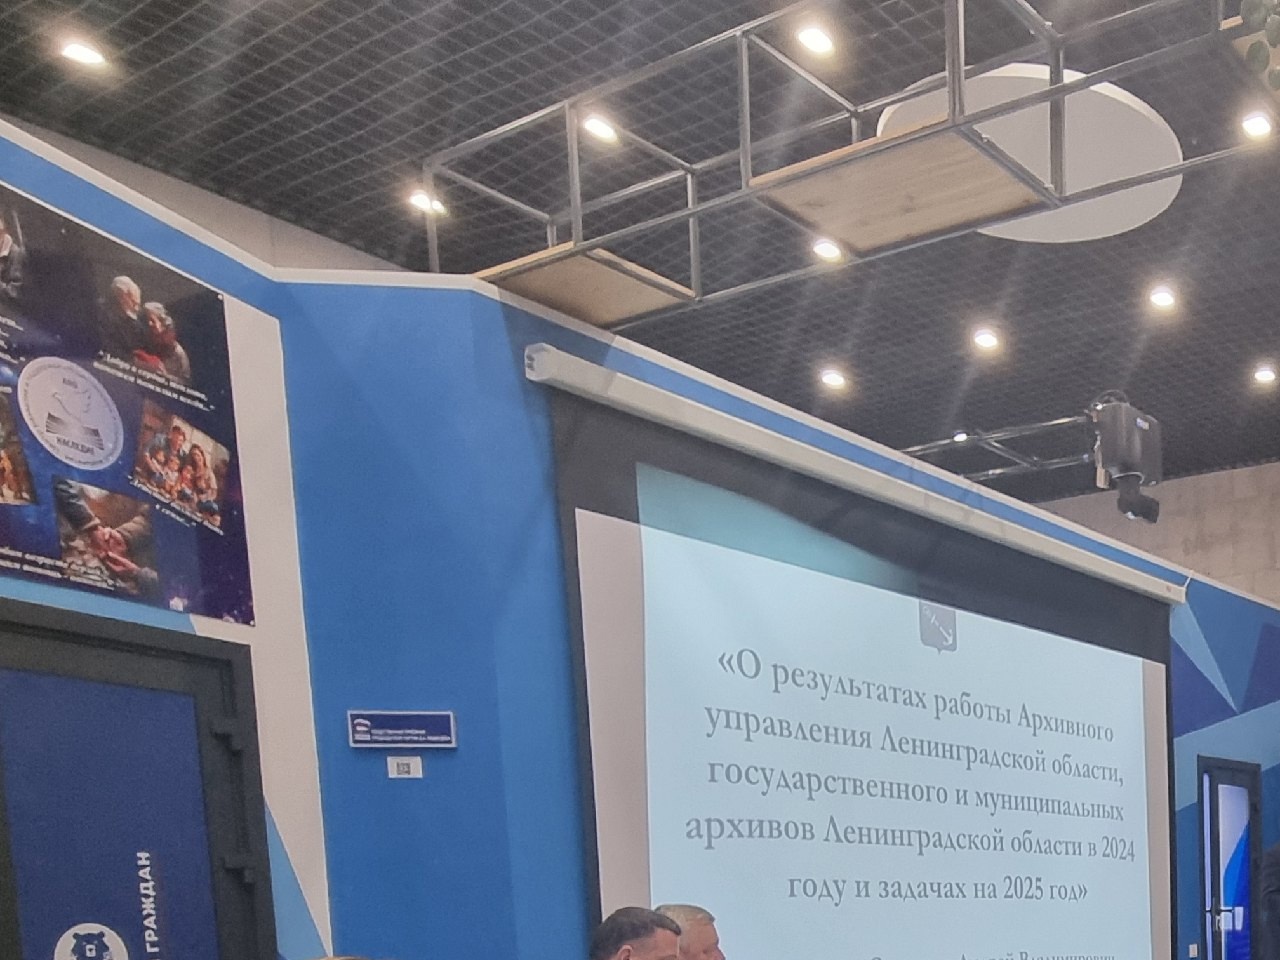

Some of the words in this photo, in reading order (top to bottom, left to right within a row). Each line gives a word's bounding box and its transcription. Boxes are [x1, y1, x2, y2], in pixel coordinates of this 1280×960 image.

[718, 648, 761, 679] «О
[771, 663, 927, 710] результатах
[934, 692, 1011, 724] работы
[1018, 702, 1114, 742] Архивного
[704, 706, 872, 748] управления
[880, 725, 1046, 771] Ленинградской
[1052, 754, 1124, 787] области,
[708, 762, 948, 803] государственного
[956, 788, 969, 806] и
[975, 790, 1124, 821] муниципальных
[685, 816, 815, 850] архивов
[823, 814, 1005, 857] Ленинградской
[1011, 829, 1082, 857] области
[1088, 844, 1097, 857] в
[1101, 835, 1135, 862] 2024
[136, 851, 159, 953] ГРАЖДАН
[788, 878, 847, 907] году
[855, 880, 871, 898] и
[878, 880, 967, 901] задачах
[974, 882, 998, 899] на
[1003, 875, 1044, 900] 2025
[1050, 883, 1088, 903] год»
